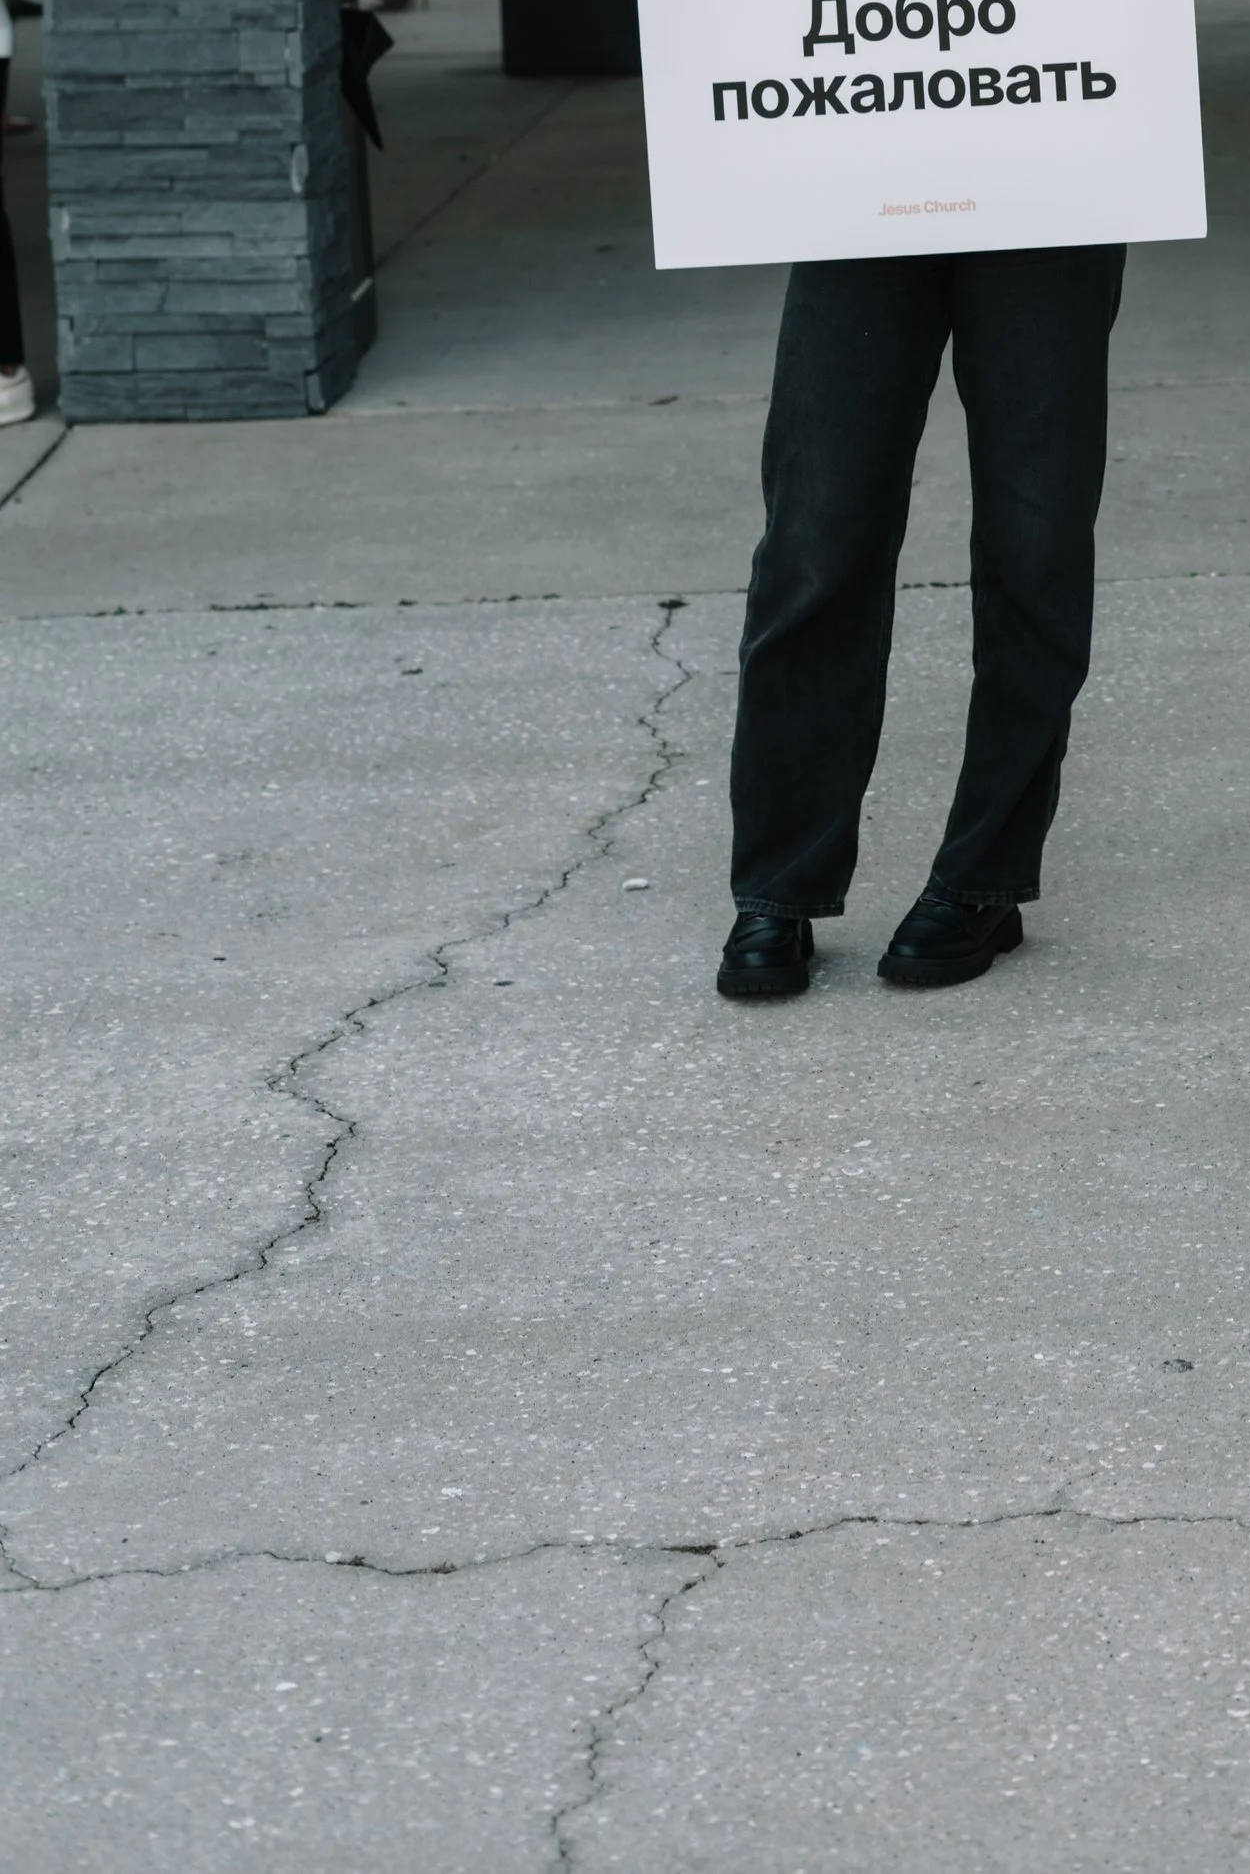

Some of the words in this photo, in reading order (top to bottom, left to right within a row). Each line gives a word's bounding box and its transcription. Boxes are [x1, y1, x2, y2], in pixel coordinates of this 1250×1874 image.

[712, 60, 1117, 122] пожаловать
[878, 203, 920, 216] Jesus
[923, 198, 977, 213] Church
